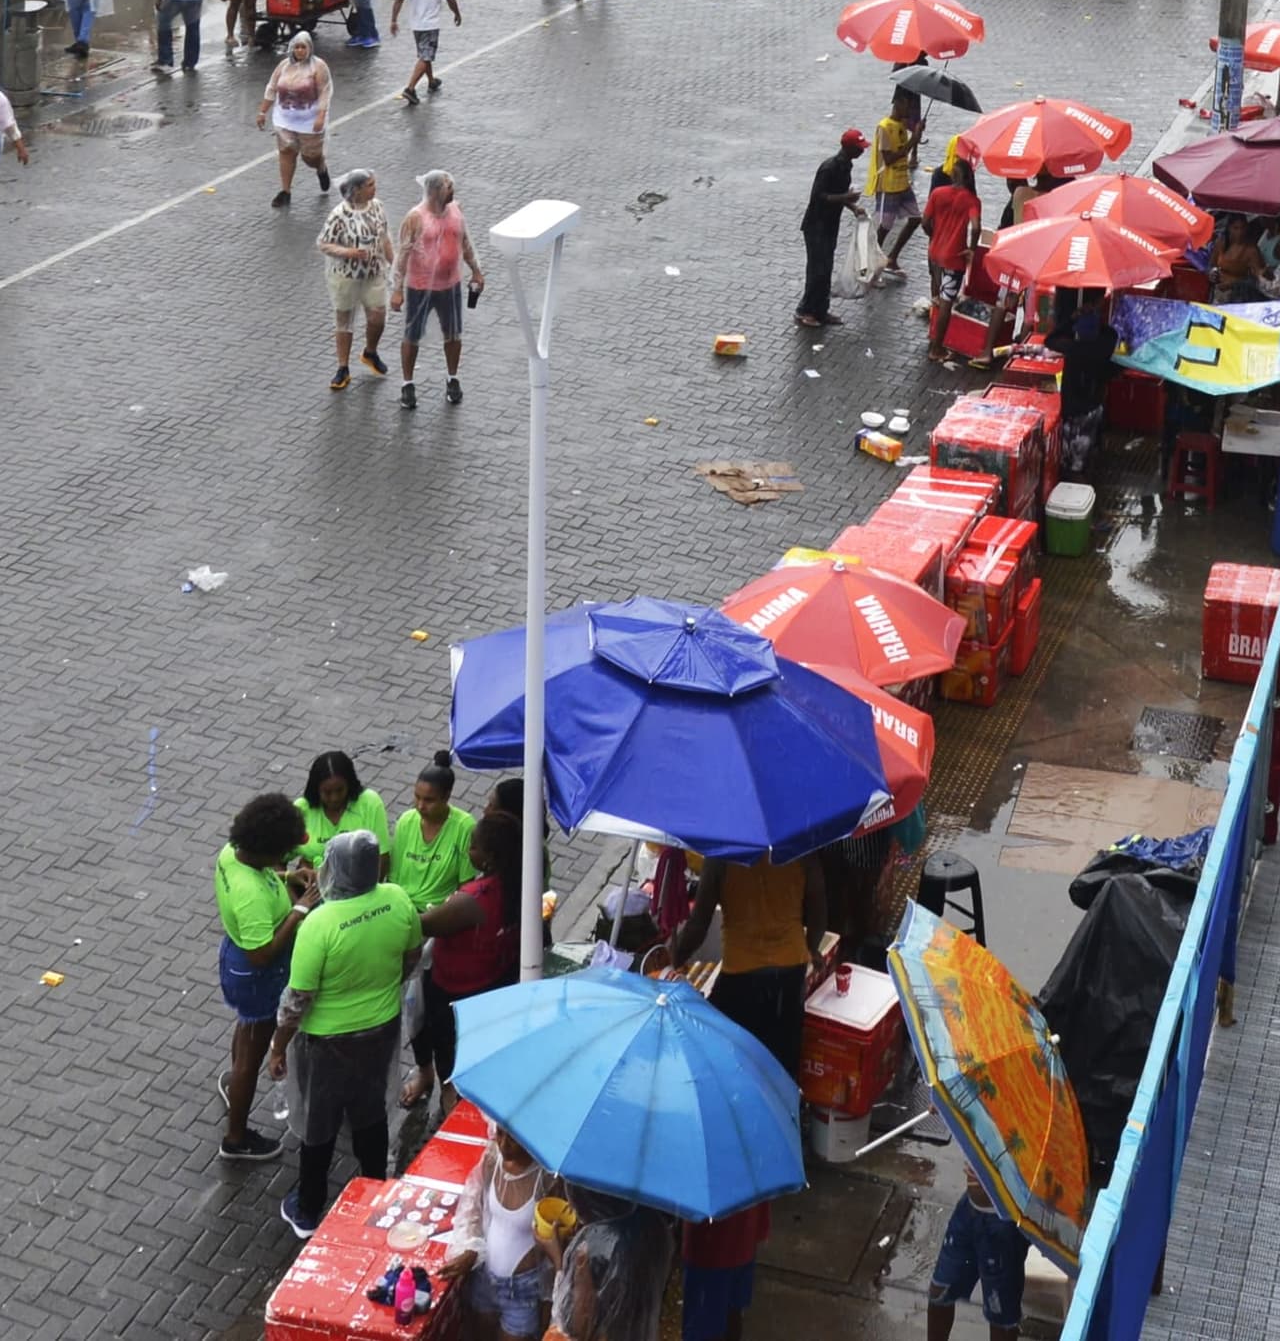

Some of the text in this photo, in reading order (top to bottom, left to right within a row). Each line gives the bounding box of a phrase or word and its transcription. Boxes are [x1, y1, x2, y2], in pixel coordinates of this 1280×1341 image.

[890, 10, 913, 45] BRAHMA
[1008, 116, 1039, 157] BRAHMA
[1064, 107, 1114, 140] BRAHMA
[1147, 187, 1198, 225] BRAHMA
[1228, 632, 1268, 658] BRA
[371, 904, 391, 917] VIVO
